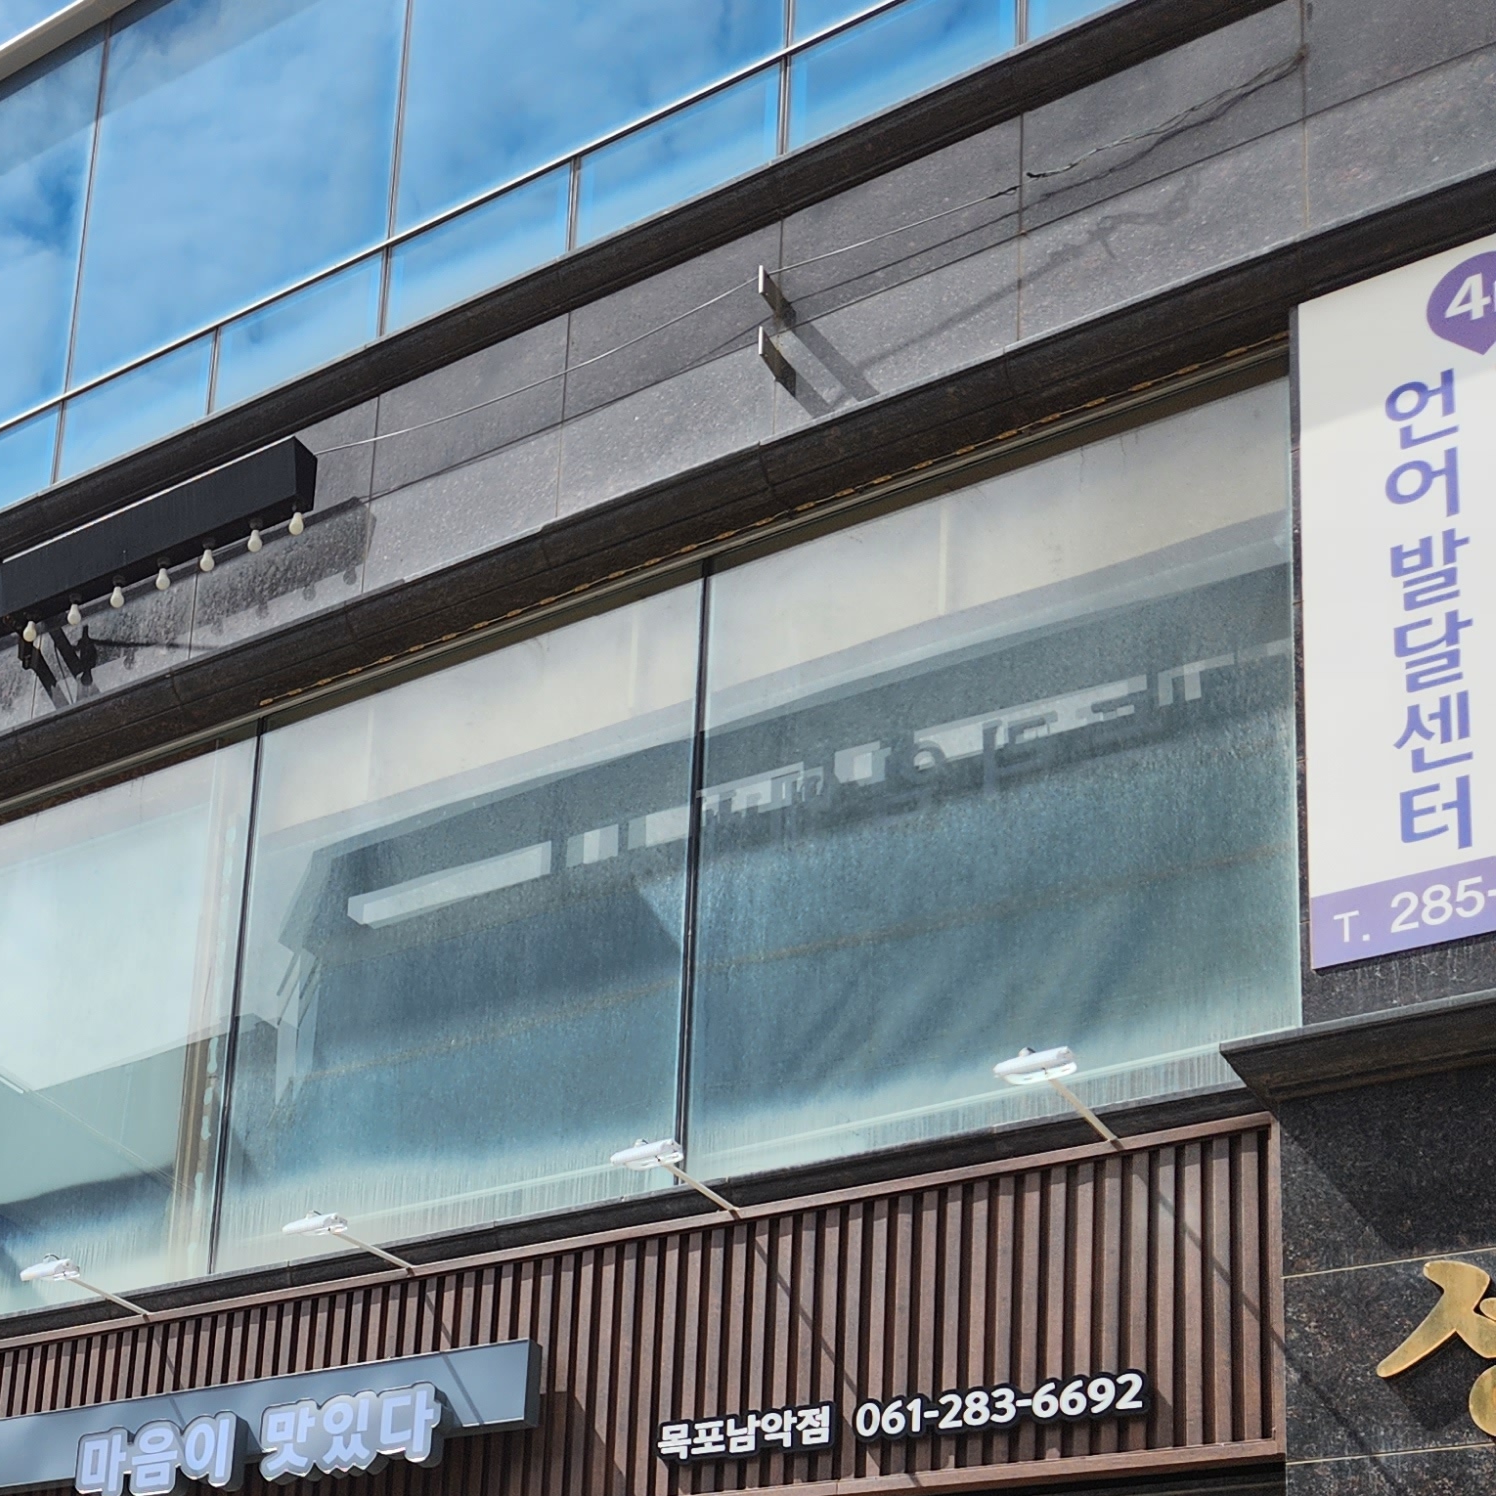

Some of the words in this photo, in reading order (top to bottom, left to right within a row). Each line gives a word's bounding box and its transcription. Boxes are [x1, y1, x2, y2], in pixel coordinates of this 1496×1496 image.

[1385, 367, 1474, 851] 언어발달센터
[1333, 910, 1370, 943] T.
[261, 1381, 441, 1483] 맛있다
[658, 1403, 832, 1462] 목포남악점
[856, 1373, 1144, 1439] 061-283-6692
